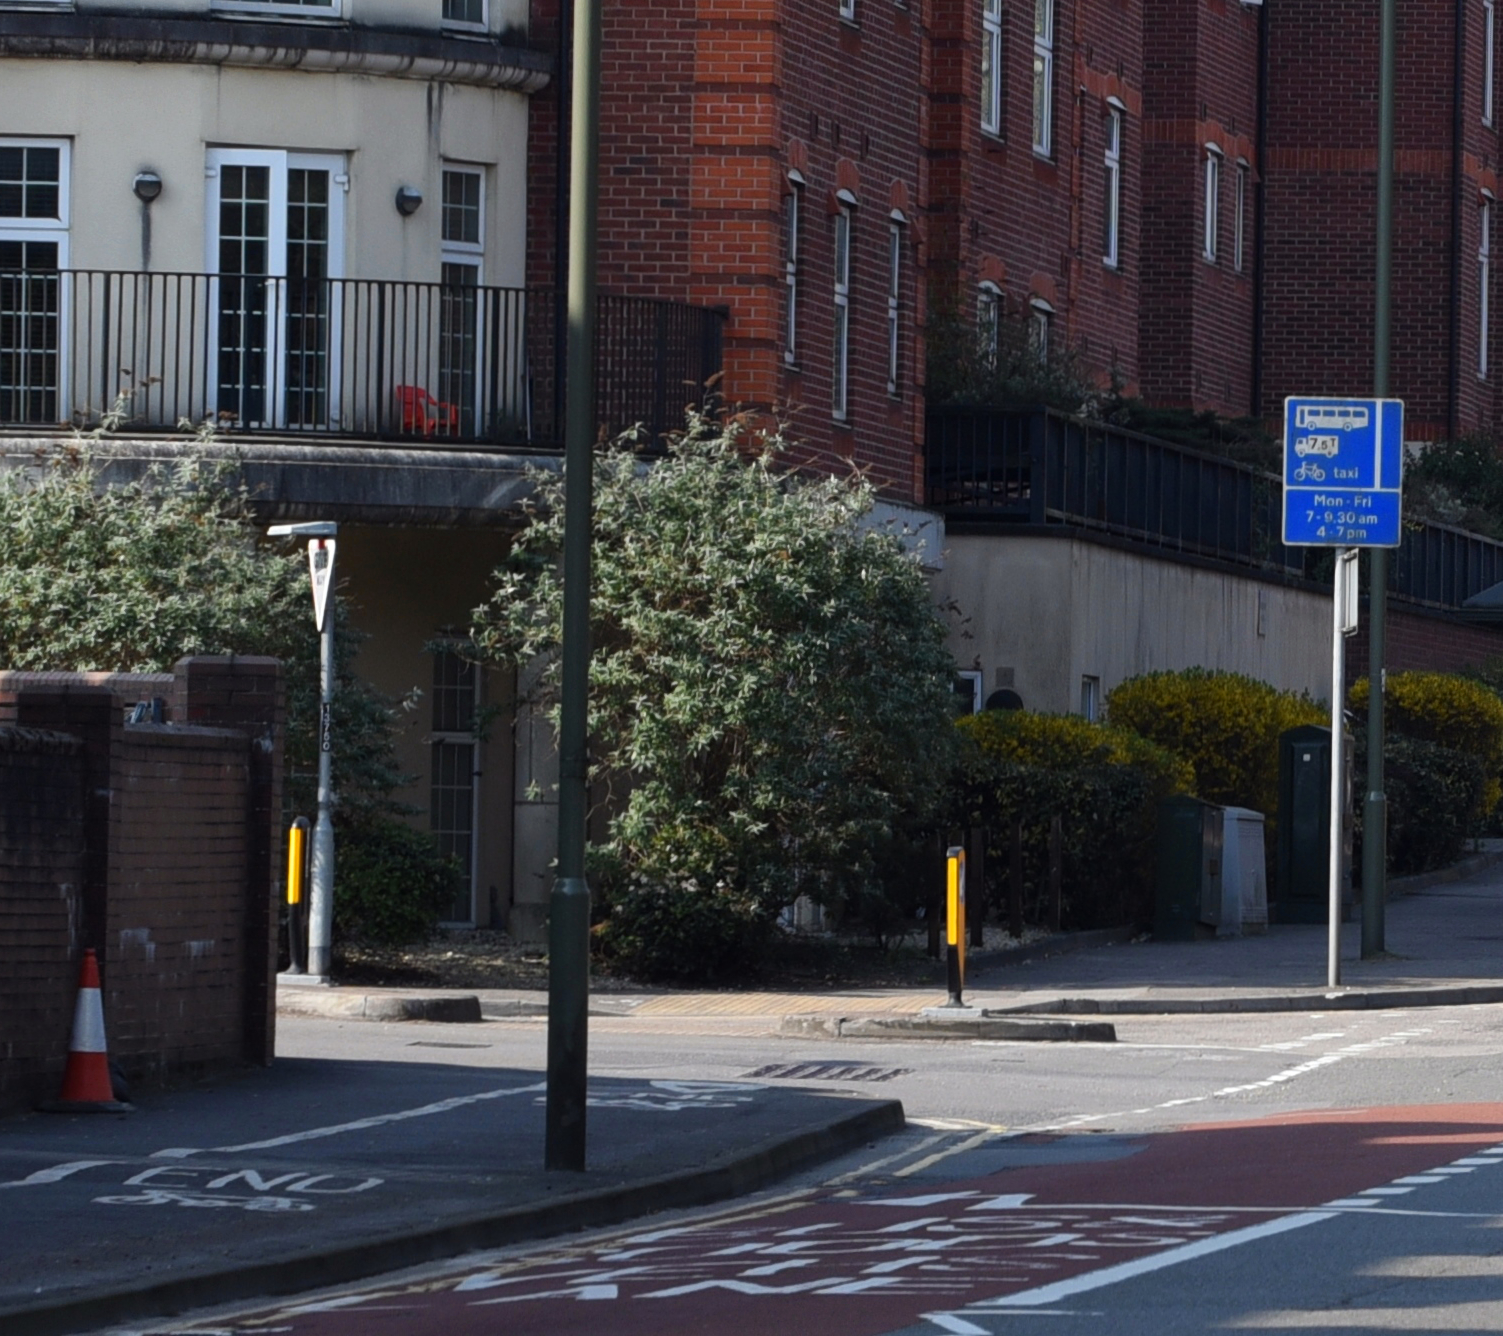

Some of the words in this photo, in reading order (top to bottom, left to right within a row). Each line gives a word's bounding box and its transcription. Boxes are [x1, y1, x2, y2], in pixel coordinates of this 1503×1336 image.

[1334, 467, 1358, 478] taxi
[1314, 495, 1343, 506] Mon
[1354, 496, 1372, 507] Fri
[1358, 514, 1378, 524] am
[1347, 529, 1366, 539] pm
[121, 1165, 385, 1195] END
